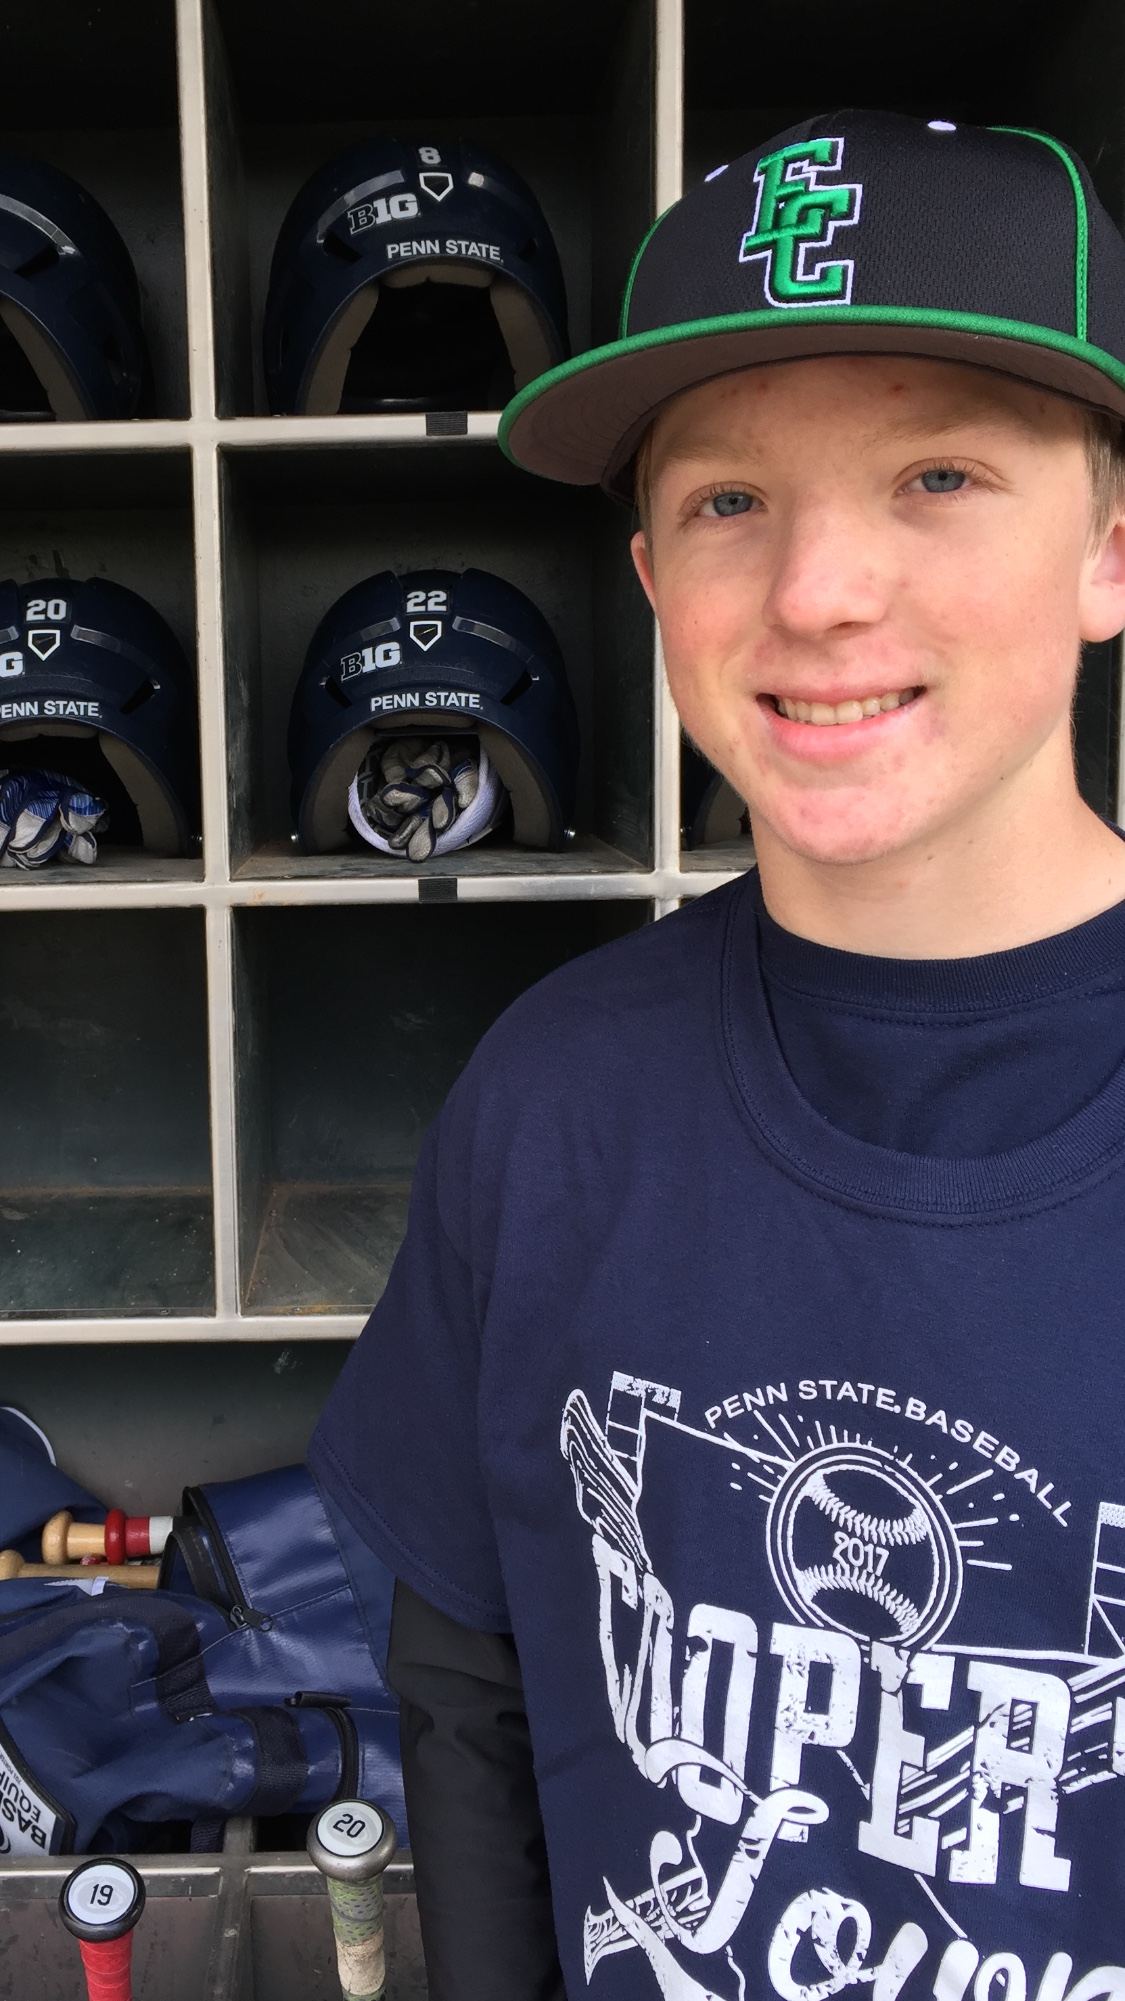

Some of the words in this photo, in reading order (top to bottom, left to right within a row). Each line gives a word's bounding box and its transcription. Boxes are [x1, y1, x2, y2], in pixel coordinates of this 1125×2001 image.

[418, 146, 442, 165] 8
[386, 239, 440, 259] PENN
[25, 598, 67, 621] 20
[406, 590, 448, 613] 22
[0, 701, 39, 719] ENN
[370, 692, 420, 712] PENN
[704, 1382, 789, 1429] PENN
[904, 1396, 1072, 1528] BASEBALL
[833, 1530, 890, 1577] 2017
[0, 1787, 47, 1850] BAS
[332, 1813, 367, 1839] 20
[88, 1883, 114, 1907] 19
